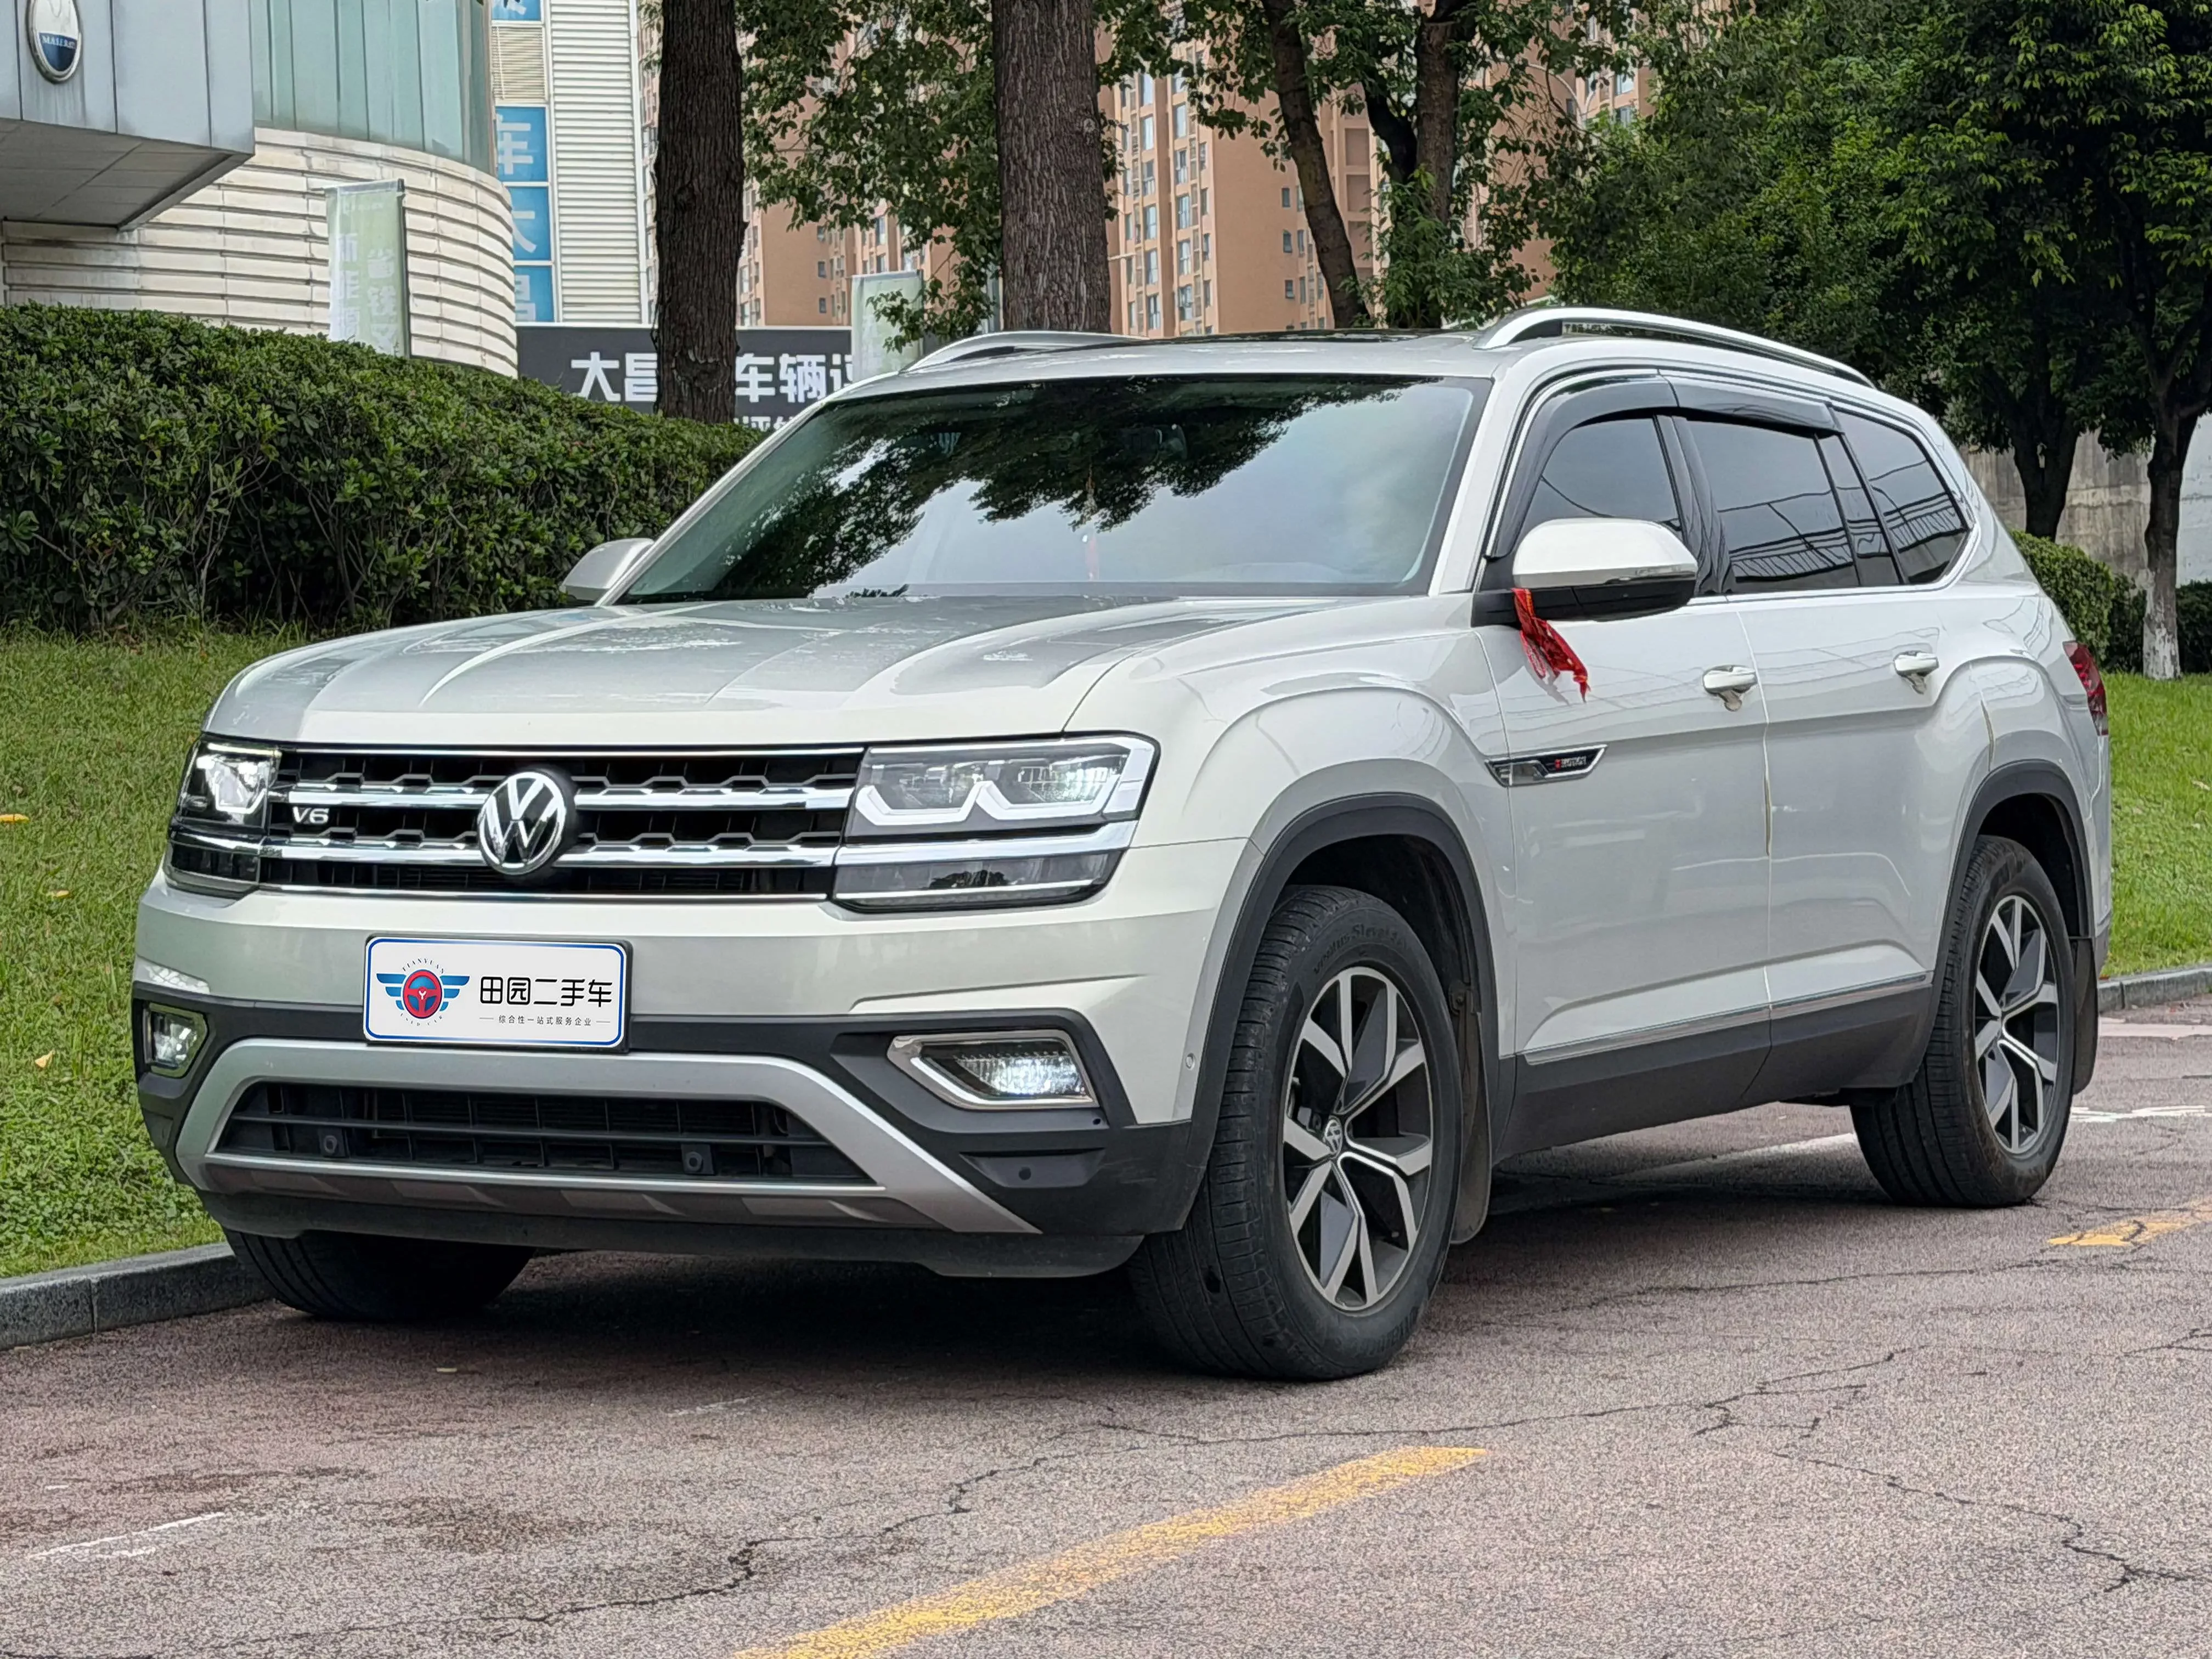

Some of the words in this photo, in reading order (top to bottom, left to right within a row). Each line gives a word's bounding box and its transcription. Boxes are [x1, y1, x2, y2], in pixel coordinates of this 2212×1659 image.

[292, 806, 329, 824] V6
[480, 977, 612, 1007] 田园二手车
[499, 1015, 591, 1026] 综合性一站式服务企业
